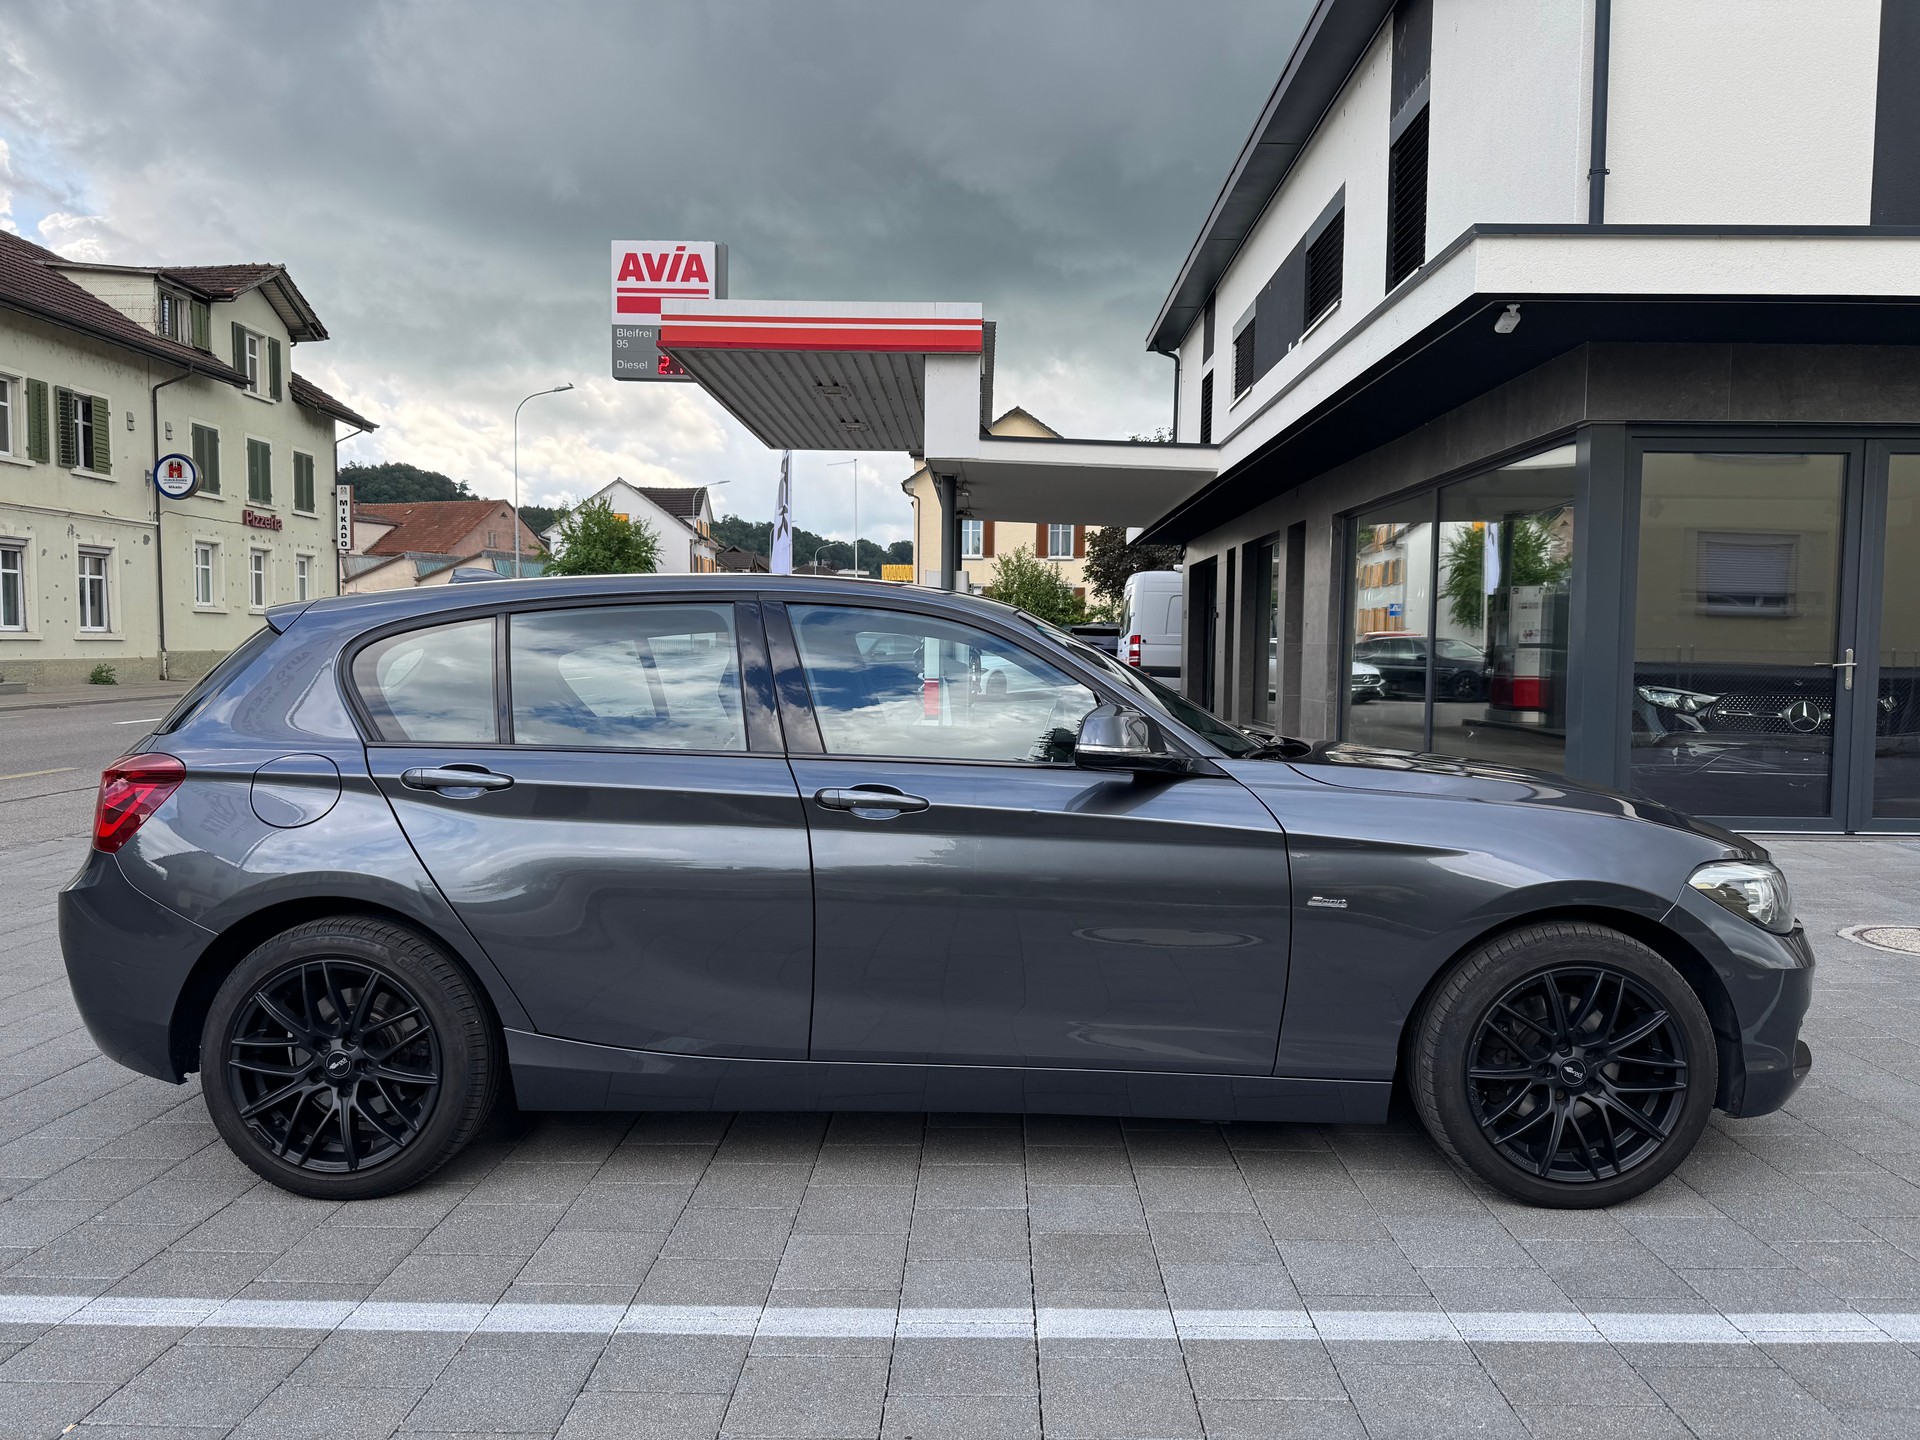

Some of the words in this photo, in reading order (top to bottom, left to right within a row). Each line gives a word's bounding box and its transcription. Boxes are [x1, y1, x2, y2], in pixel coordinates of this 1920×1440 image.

[616, 328, 653, 338] Bleifrei
[616, 339, 629, 349] 95
[616, 360, 648, 370] Diesel
[243, 510, 283, 531] Pizzeria
[339, 500, 348, 547] MIKADO
